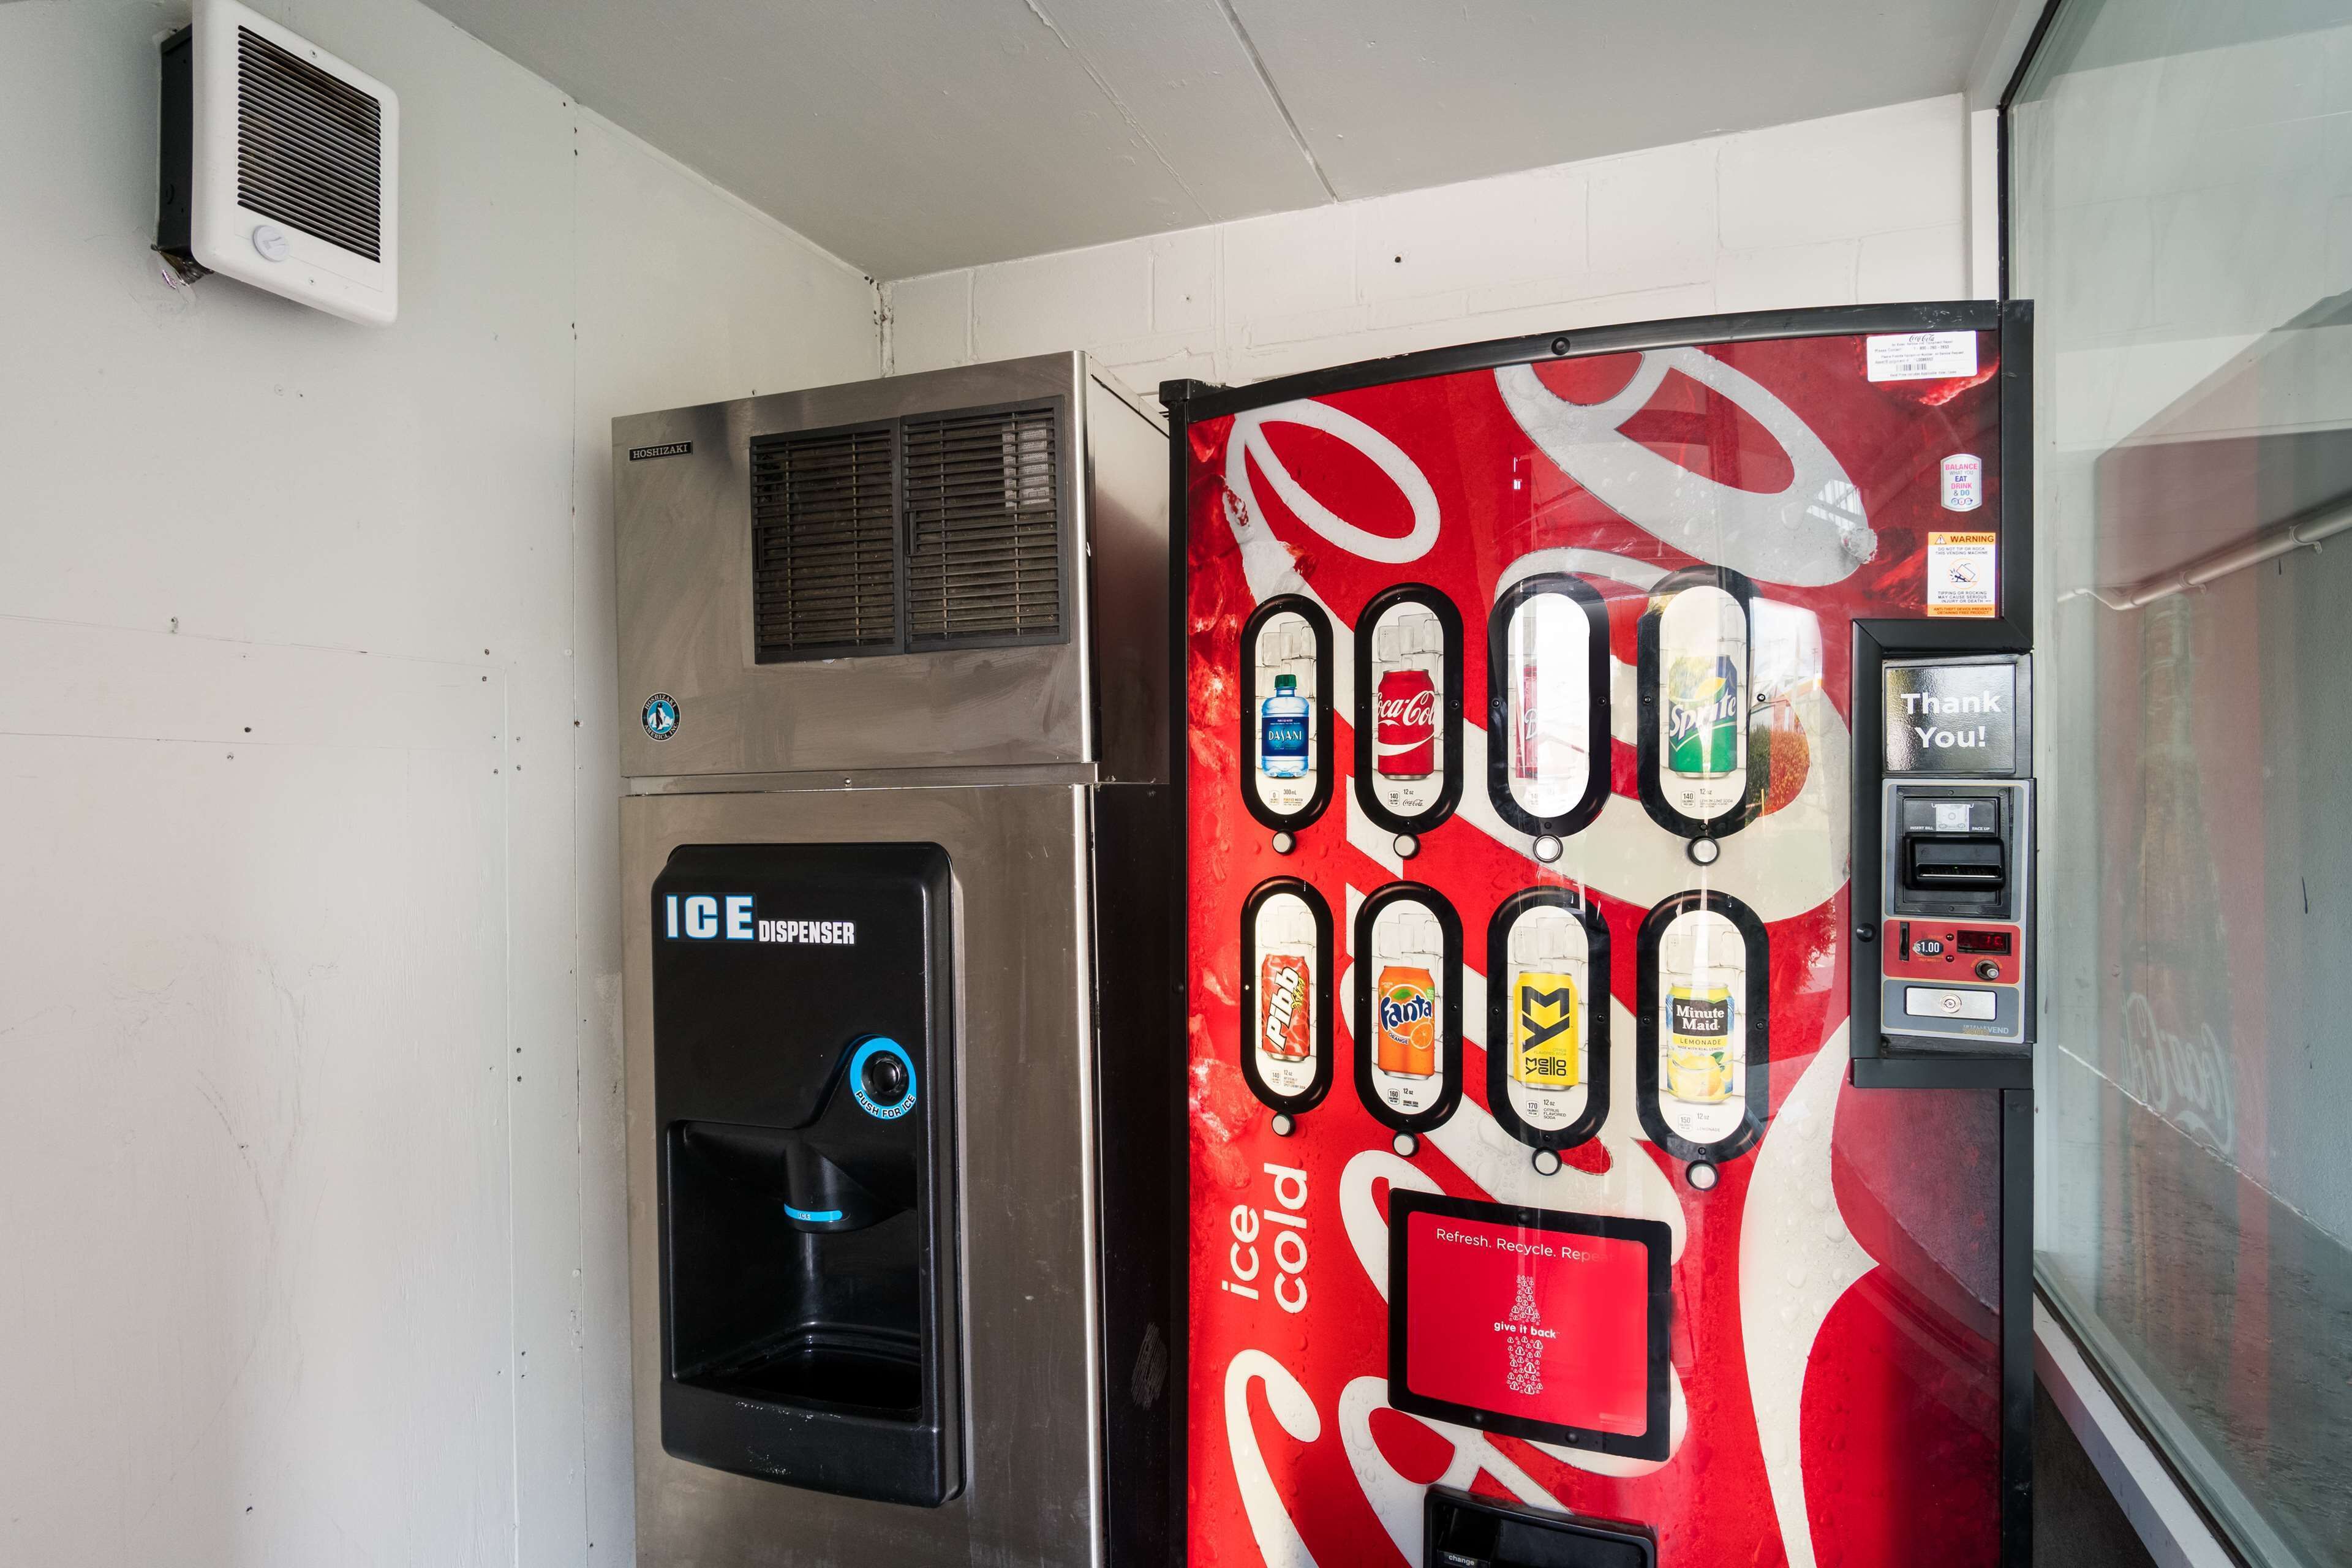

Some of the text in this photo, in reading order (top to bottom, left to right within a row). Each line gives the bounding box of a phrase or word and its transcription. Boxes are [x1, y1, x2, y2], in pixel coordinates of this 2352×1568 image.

[633, 444, 687, 458] HOSHIZAKI
[644, 694, 677, 710] HOSHIZAKI
[1900, 691, 2002, 715] Thank
[1269, 729, 1302, 741] DASANI
[1914, 726, 1986, 748] You!
[666, 895, 854, 944] ICE DISPENSER
[1915, 941, 1940, 953] $1.00
[1381, 993, 1432, 1032] Fanta
[1676, 1005, 1725, 1019] Minute
[1682, 1017, 1719, 1030] Maid
[1388, 1032, 1409, 1044] ORANGE
[1525, 1057, 1566, 1068] Mello
[856, 1090, 916, 1118] PUSH FOR ICE
[1264, 1163, 1308, 1314] cold
[1436, 1227, 1492, 1249] Refresh.
[1496, 1238, 1556, 1257] Recycle.
[1221, 1205, 1259, 1300] ice
[1494, 1321, 1556, 1339] give it back
[1448, 1553, 1475, 1566] change
